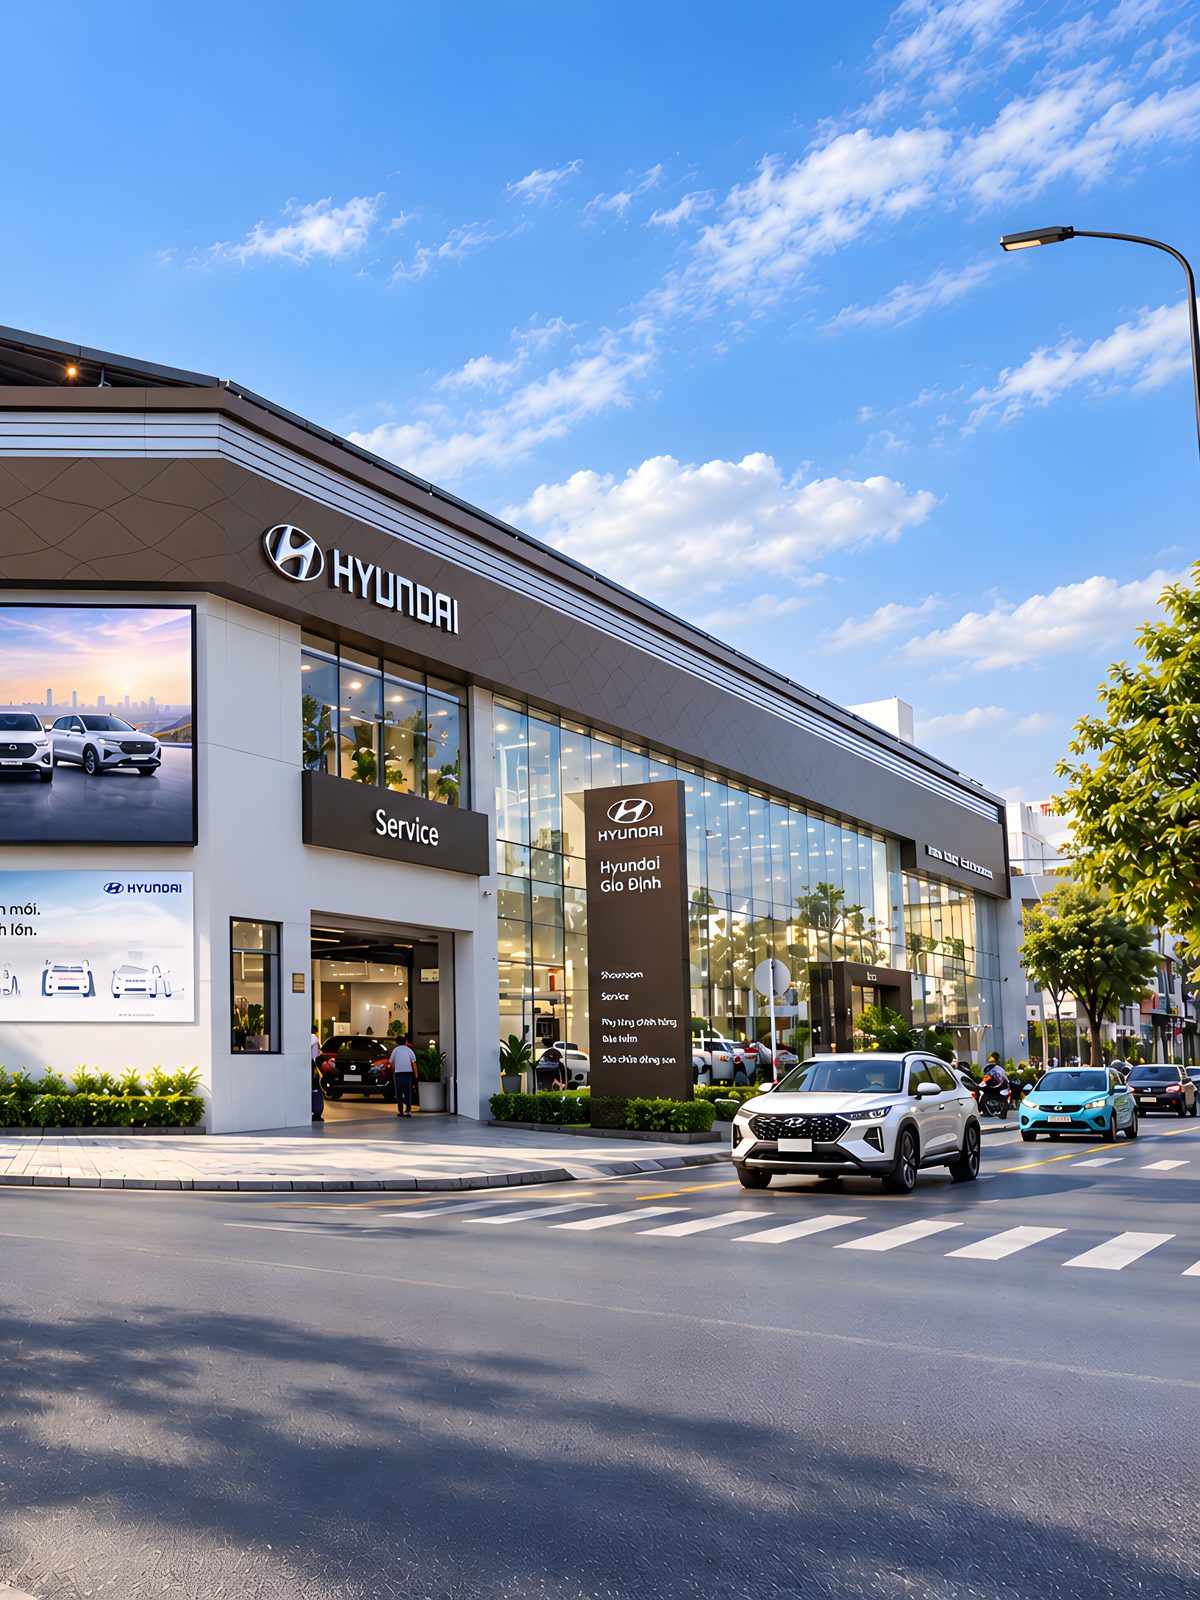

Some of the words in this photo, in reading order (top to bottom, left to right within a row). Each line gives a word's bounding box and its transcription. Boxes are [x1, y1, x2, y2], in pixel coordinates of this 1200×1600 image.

[332, 548, 459, 635] HYUNDAI
[375, 808, 439, 847] Service
[598, 825, 663, 842] HYUNDAI
[127, 883, 182, 894] HYUNDAI
